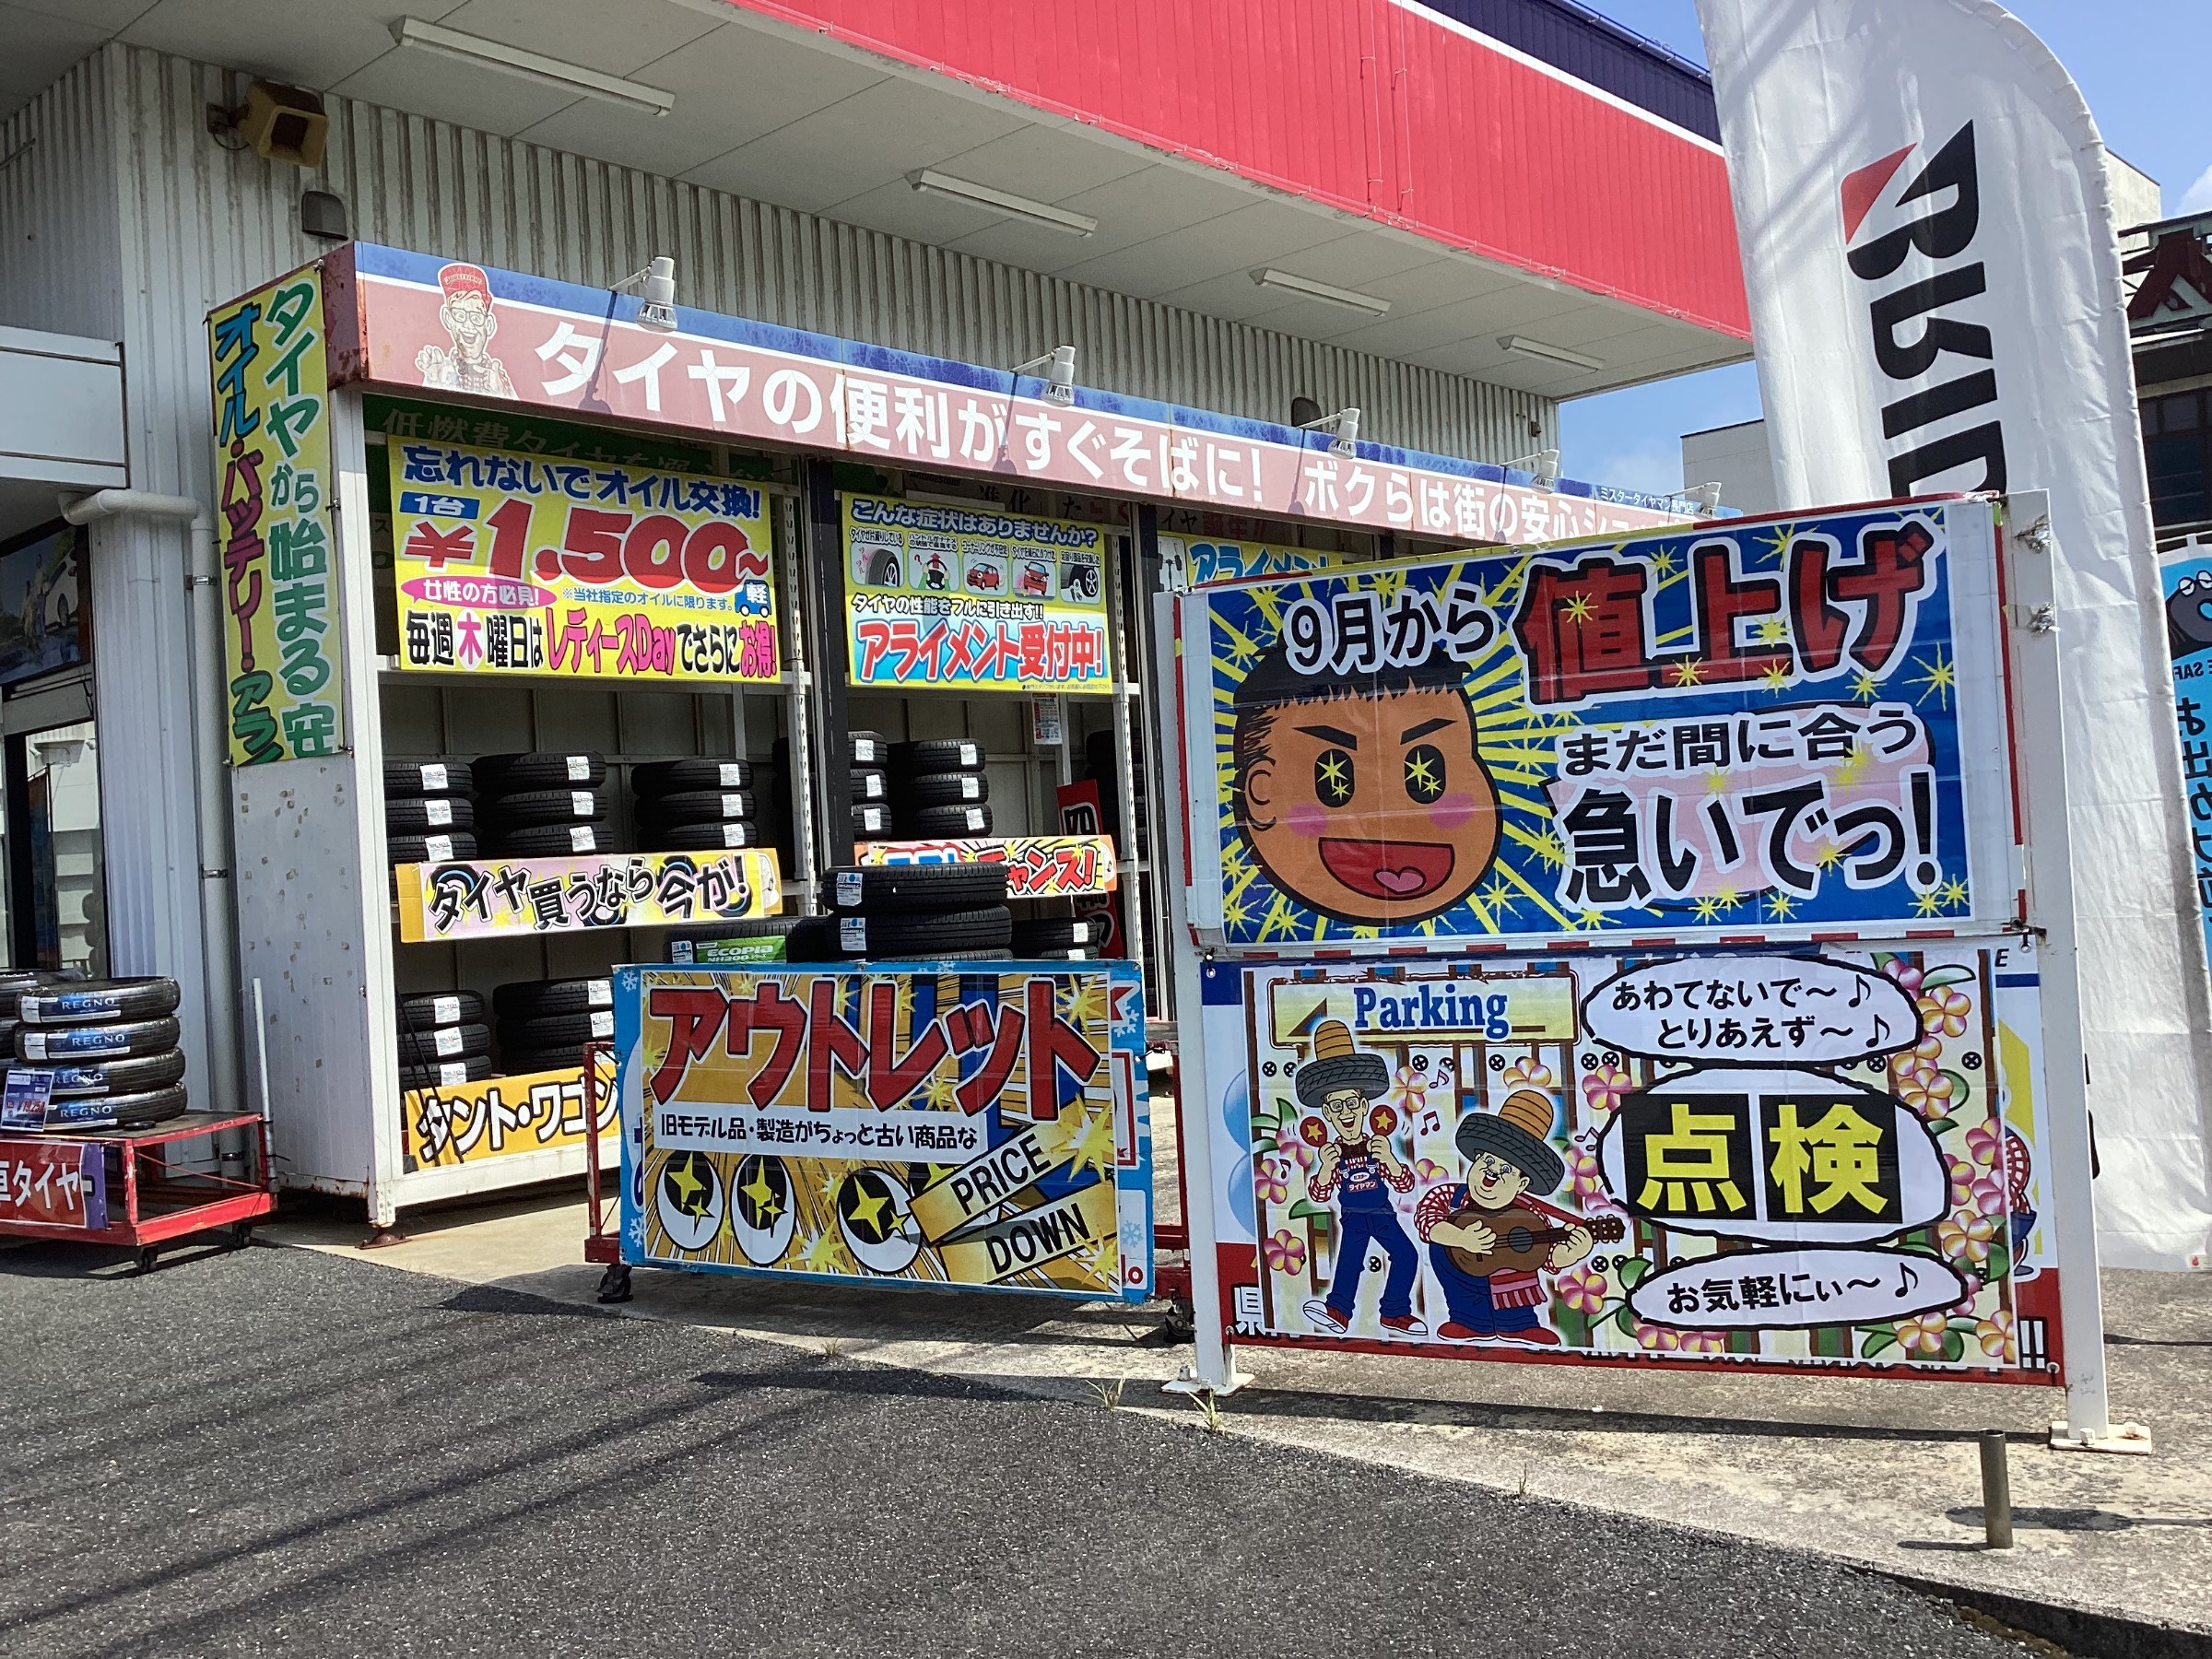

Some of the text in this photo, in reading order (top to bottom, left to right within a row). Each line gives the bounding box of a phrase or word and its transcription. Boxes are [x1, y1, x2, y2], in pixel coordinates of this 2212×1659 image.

[535, 322, 1680, 542] タイヤの便利がすぐそばに! ボクらは街の安心シ
[403, 445, 760, 519] 忘れないでオイル交換!
[414, 495, 465, 515] 1台
[1600, 487, 1695, 515] ミスタータイヤマン長門店
[852, 500, 1099, 546] こんな症状はありませんか?
[424, 579, 540, 606] 女性の方必見!
[747, 582, 770, 605] 軽
[853, 594, 1044, 620] タイヤの性能をフルに引き出す!!
[1520, 520, 1935, 704] 値上げ
[856, 620, 1104, 680] アライメント受付中!
[1290, 586, 1495, 669] 9月から
[1564, 709, 1918, 776] まだ間に合う
[1567, 771, 1937, 905] 急いでっ!
[429, 854, 747, 933] タイヤ買うなら今が!
[62, 997, 115, 1011] REGNO
[1353, 983, 1510, 1040] Parking
[71, 1033, 126, 1047] REGNO
[649, 976, 1102, 1121] アウトレット
[60, 1105, 112, 1118] REGNO
[661, 1113, 979, 1150] 旧モデル品・製造がちょっと古い商品な
[949, 1130, 1052, 1217] PRICE
[1636, 1102, 1889, 1215] 点検
[990, 1202, 1091, 1276] DOWN
